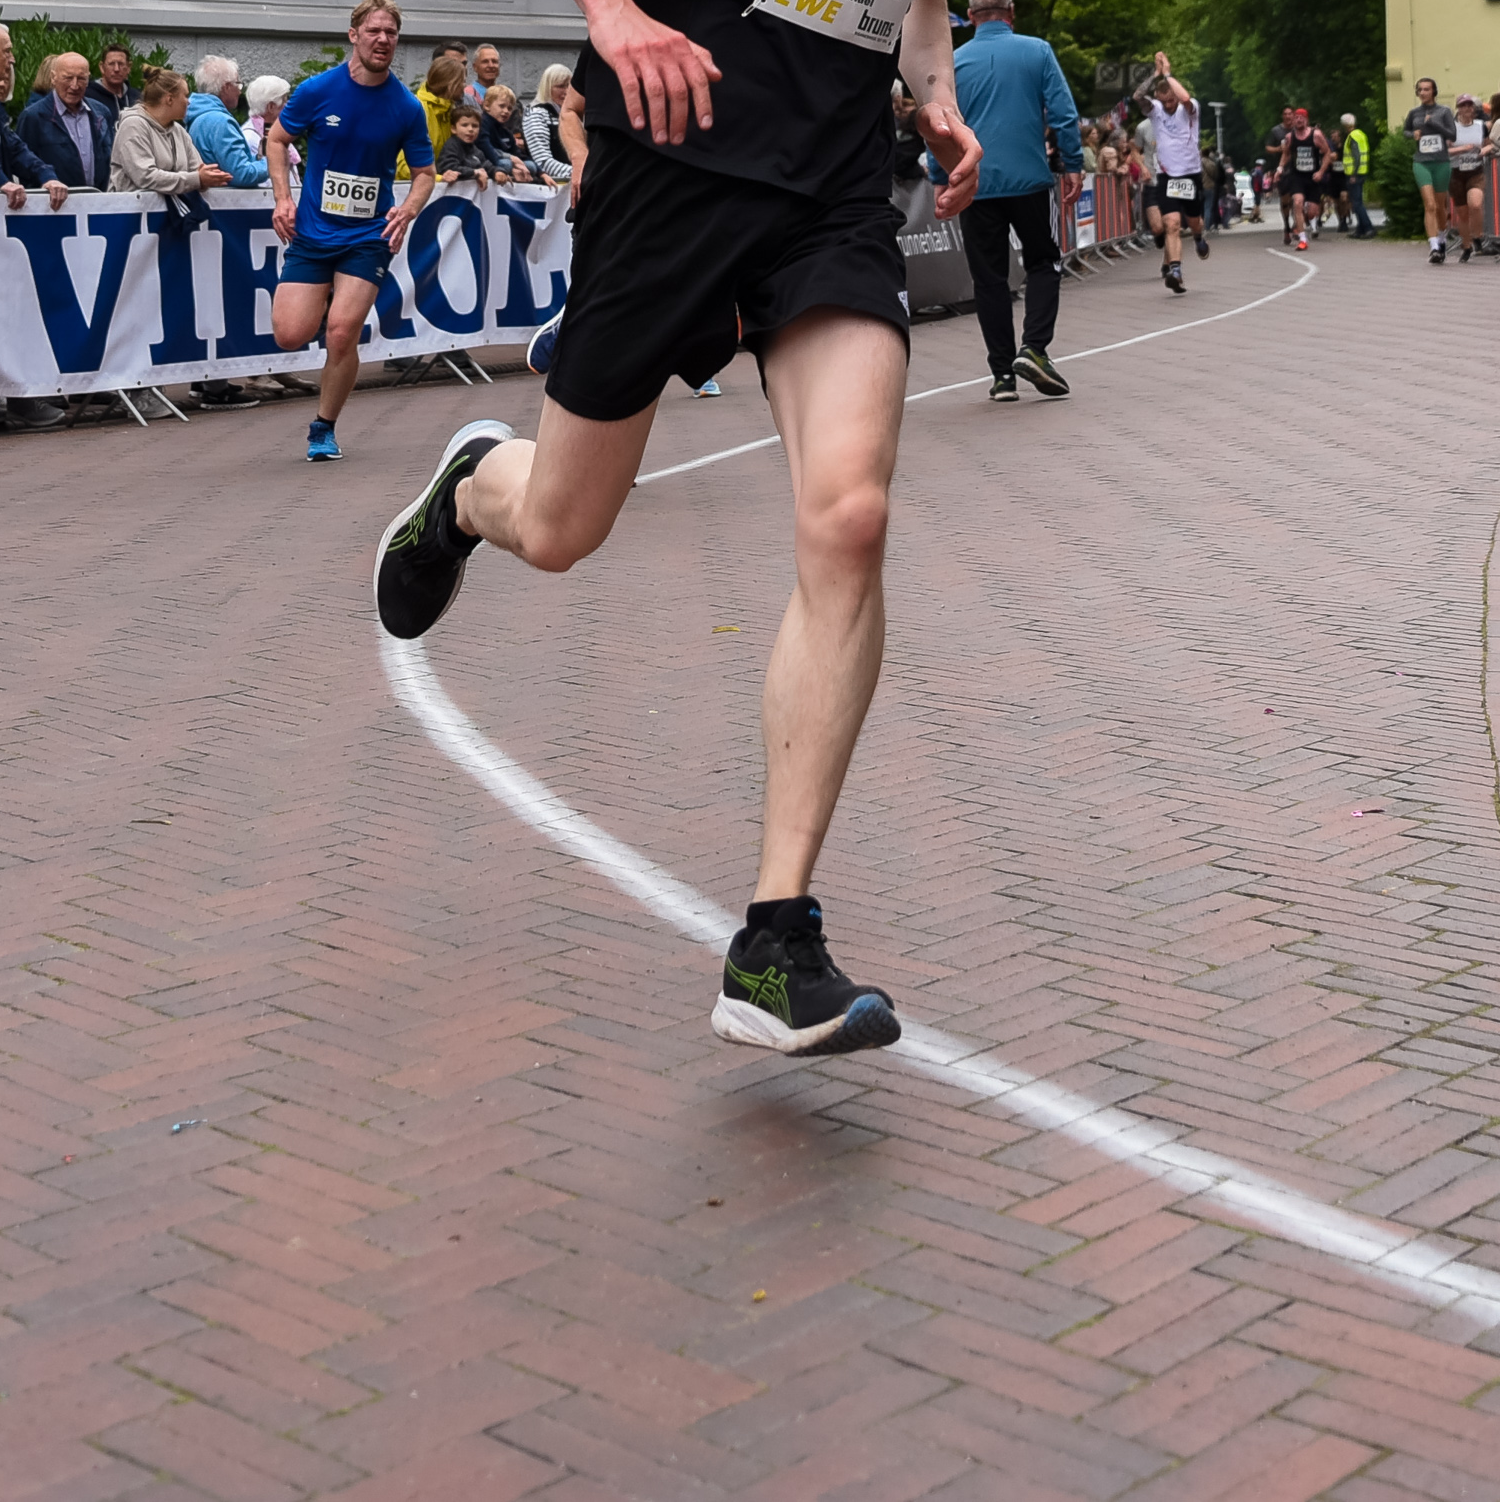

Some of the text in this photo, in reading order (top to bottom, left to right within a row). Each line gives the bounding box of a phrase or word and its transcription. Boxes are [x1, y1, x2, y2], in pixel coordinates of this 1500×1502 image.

[858, 9, 895, 38] bruns
[324, 179, 377, 202] 3066
[1168, 181, 1194, 192] 2903
[325, 201, 346, 212] EWE
